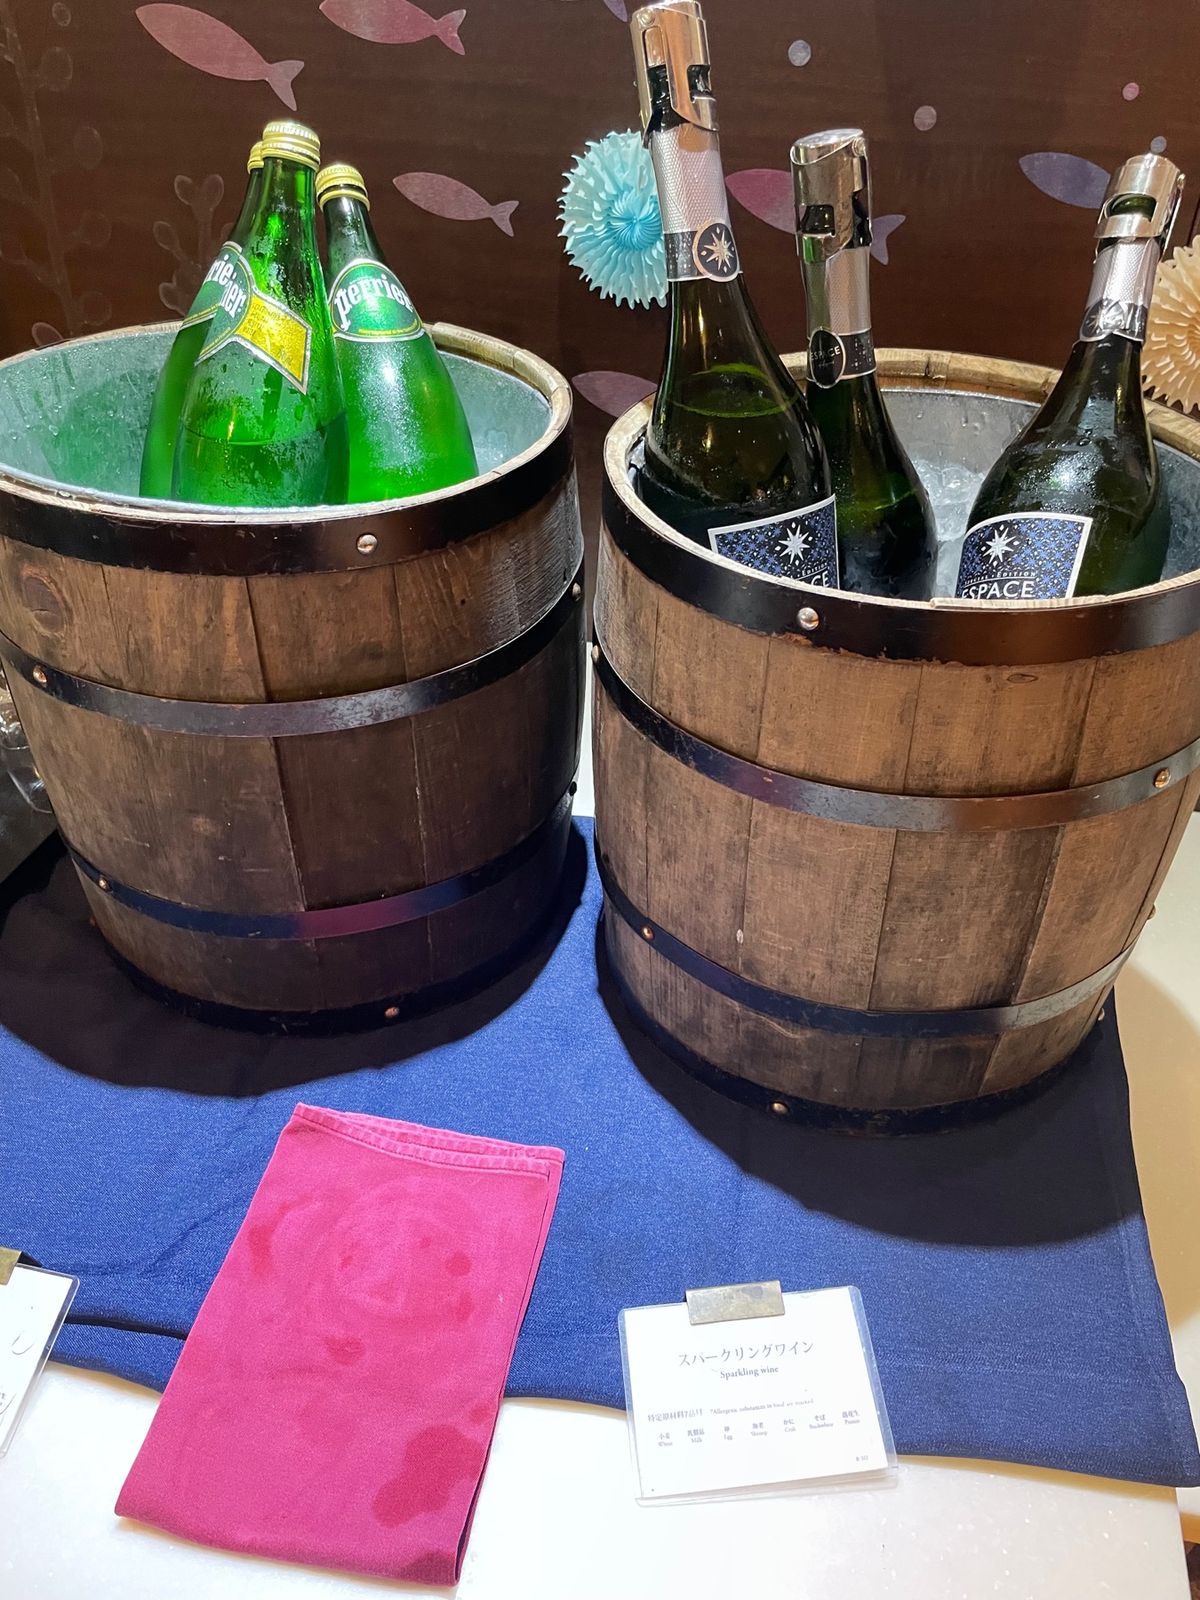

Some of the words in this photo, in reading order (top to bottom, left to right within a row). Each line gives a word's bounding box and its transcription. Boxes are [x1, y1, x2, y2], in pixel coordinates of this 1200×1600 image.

[334, 273, 414, 331] perrier
[961, 580, 1036, 600] ESPACE
[678, 1340, 814, 1367] スパークリングワイン
[720, 1367, 760, 1381] Sparkling
[760, 1365, 780, 1375] wine
